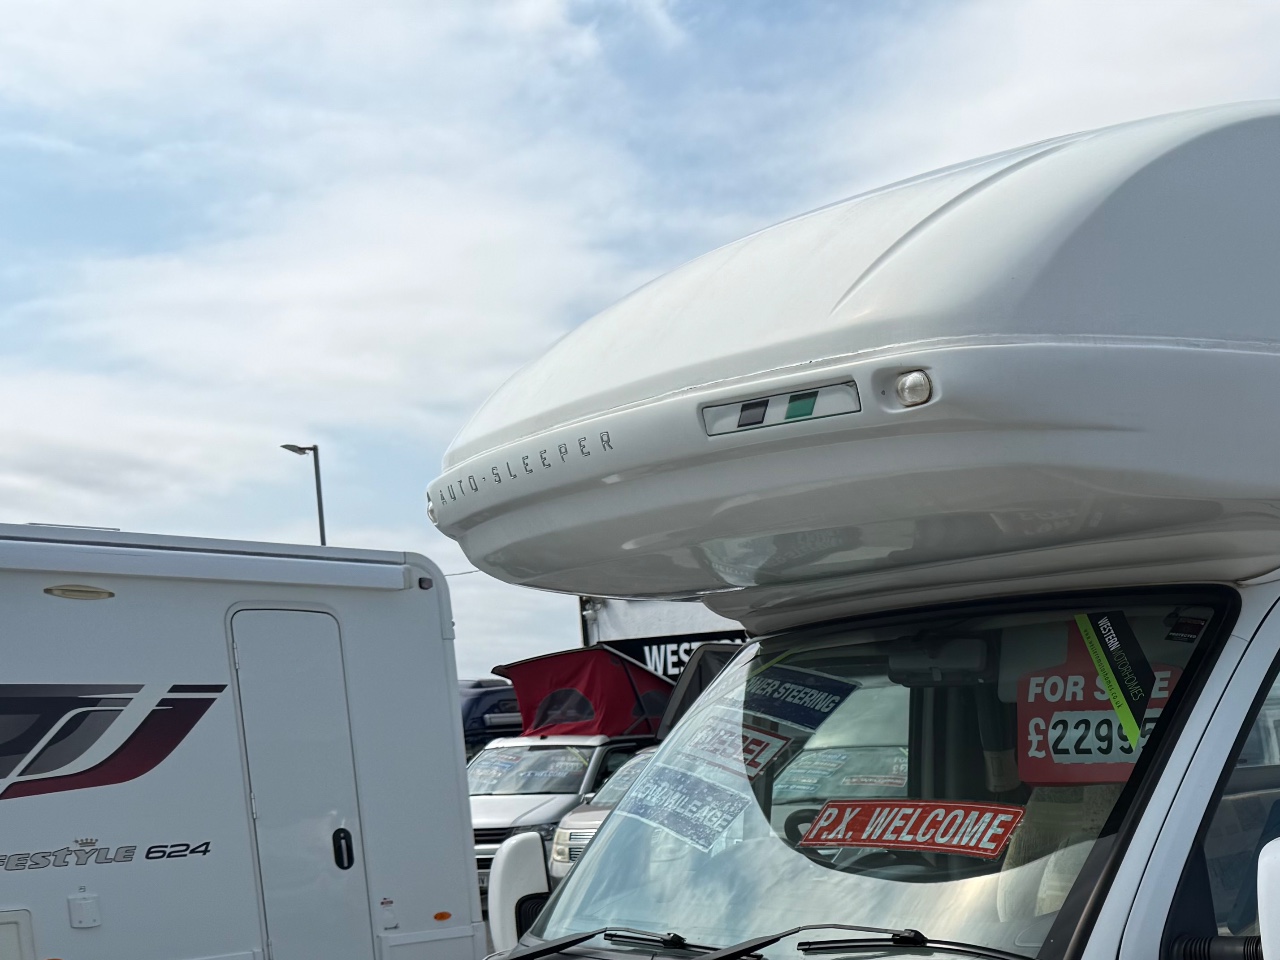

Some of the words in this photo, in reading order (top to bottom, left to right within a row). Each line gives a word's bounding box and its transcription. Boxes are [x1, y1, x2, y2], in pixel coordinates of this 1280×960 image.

[773, 682, 841, 713] STEERING
[1028, 675, 1085, 703] FOR
[1093, 671, 1172, 702] SE
[860, 807, 1013, 849] WELCOME
[145, 841, 211, 860] 624
